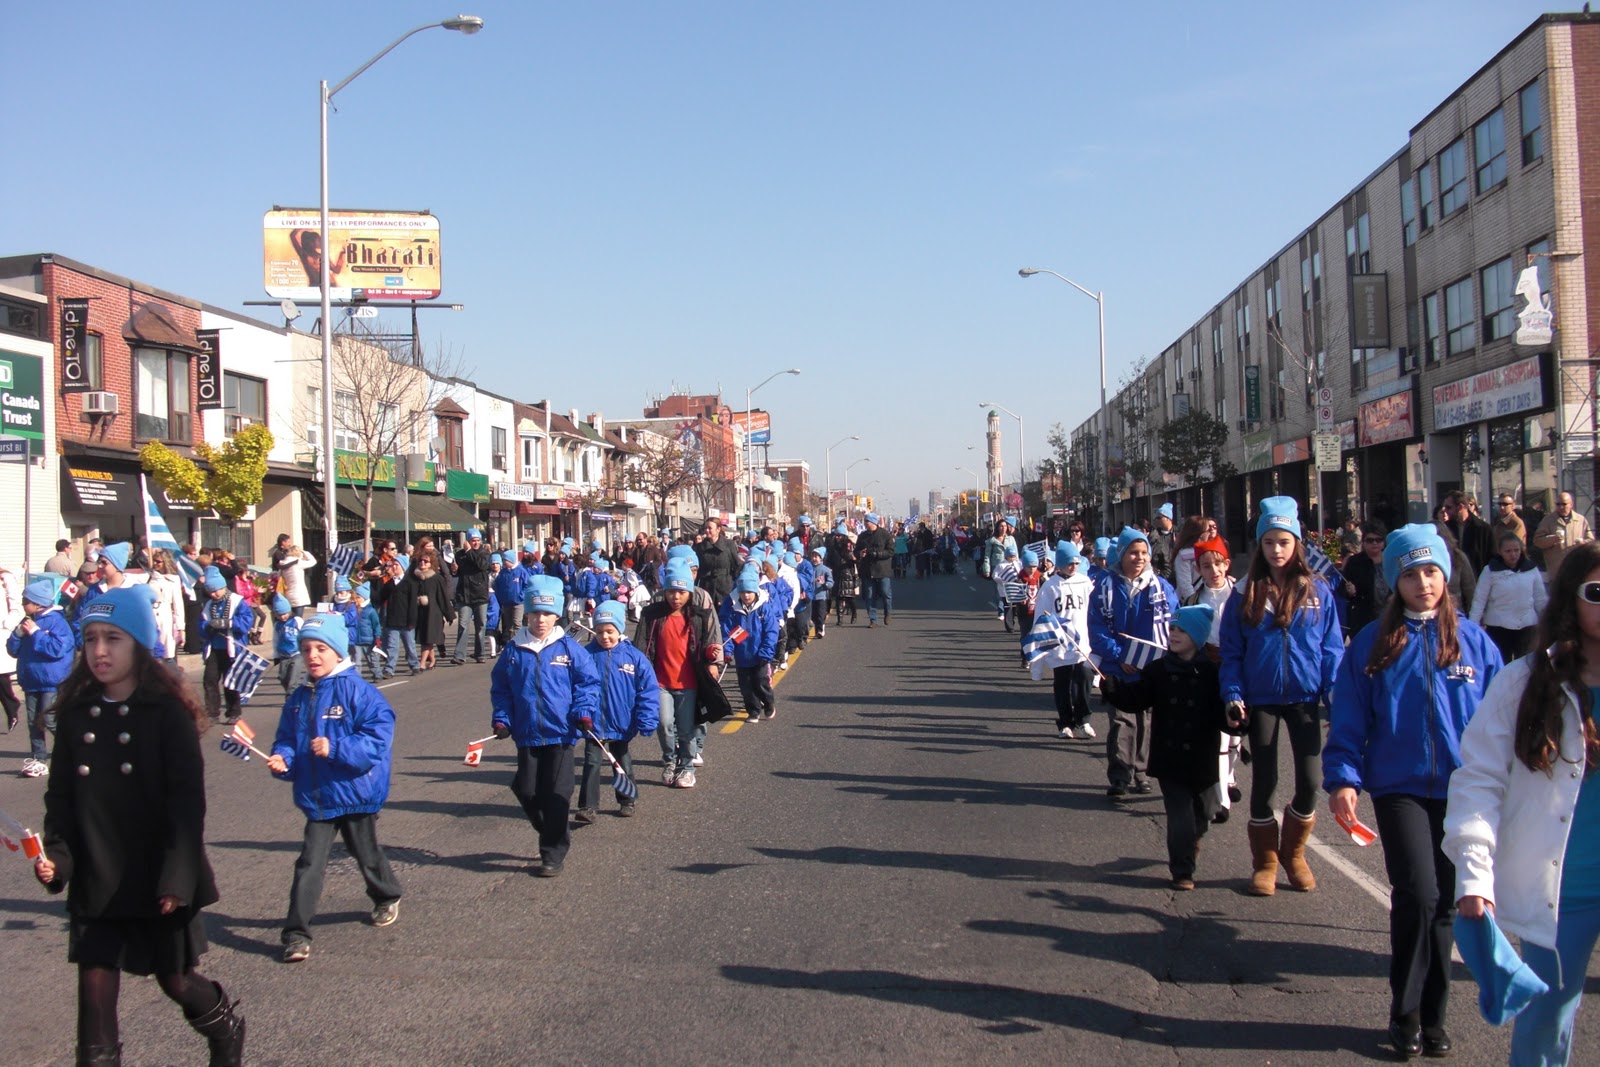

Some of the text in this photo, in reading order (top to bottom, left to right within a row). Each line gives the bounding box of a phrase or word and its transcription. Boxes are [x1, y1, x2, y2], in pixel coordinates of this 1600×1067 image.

[349, 220, 407, 228] PERFORMANCES
[346, 242, 434, 265] Bharati
[1435, 379, 1469, 404] RIVERDALE
[1504, 360, 1540, 386] HOSPITAL
[2, 392, 40, 410] Canada
[2, 409, 33, 426] Trust
[90, 604, 114, 613] GREECE
[1054, 594, 1084, 614] GAP
